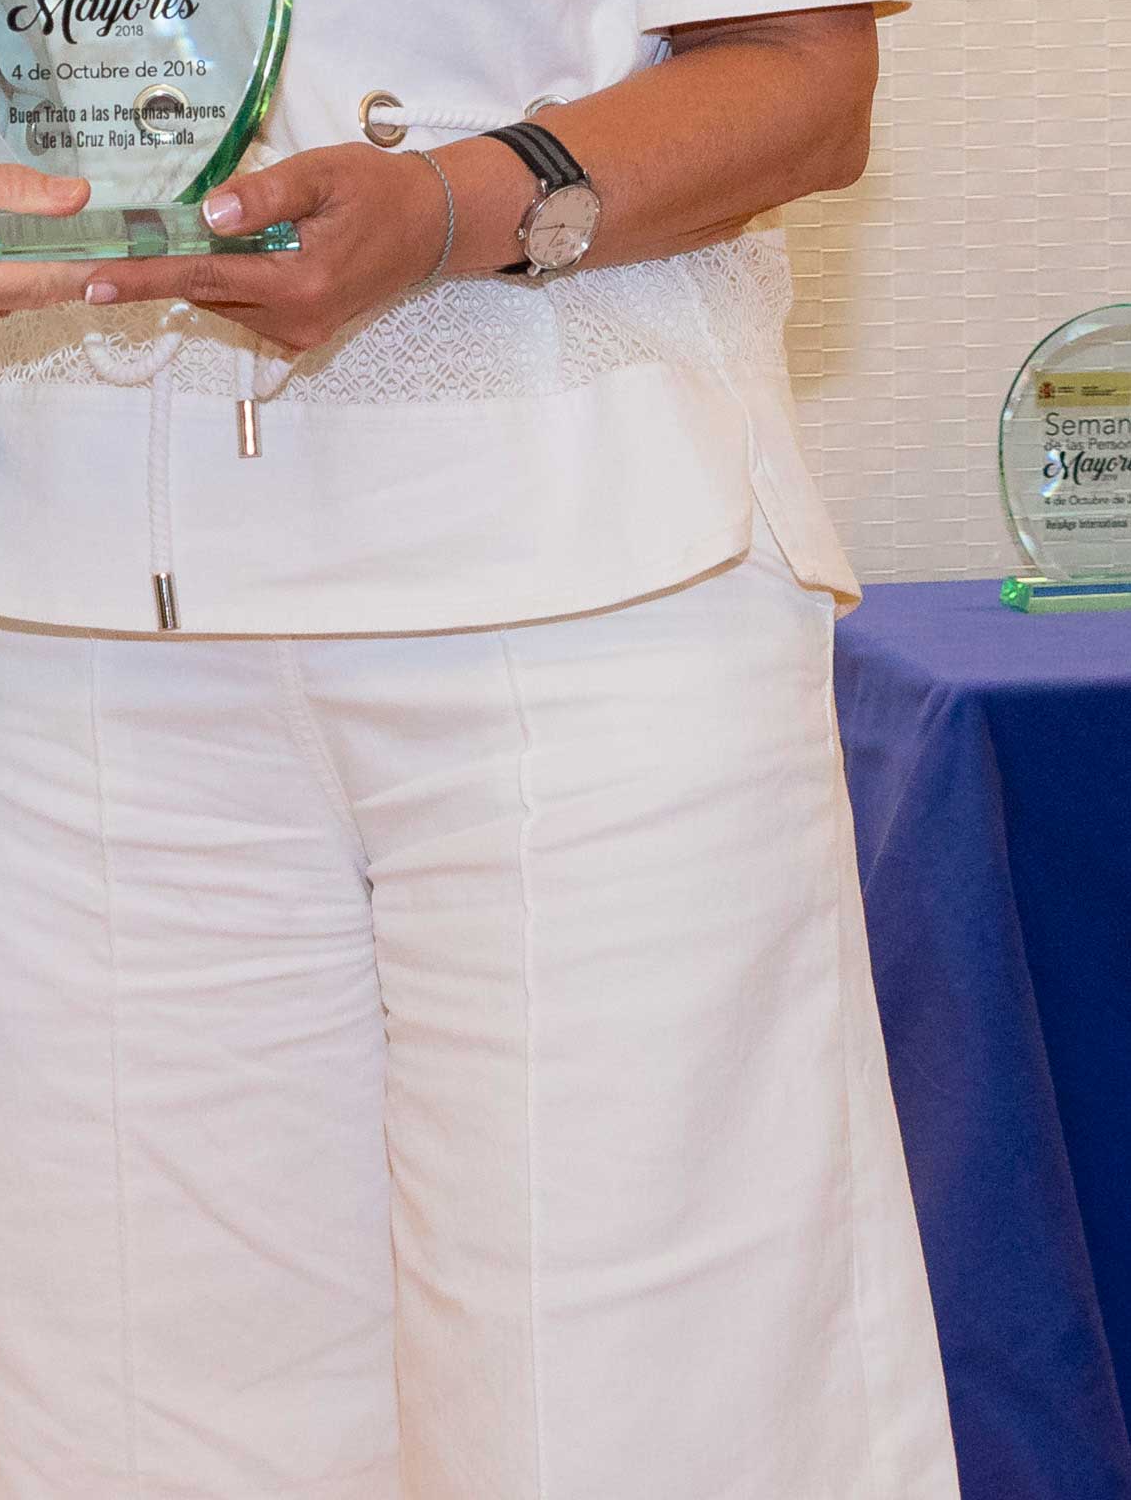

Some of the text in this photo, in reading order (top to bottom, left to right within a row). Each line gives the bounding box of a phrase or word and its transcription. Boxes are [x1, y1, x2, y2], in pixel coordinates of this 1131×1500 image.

[114, 24, 144, 37] 2018
[11, 59, 207, 81] 4 de Octubre de 2018
[9, 102, 226, 124] Buen Trato a las Personas Mayores
[42, 128, 195, 150] de la Cruz Roja Espola
